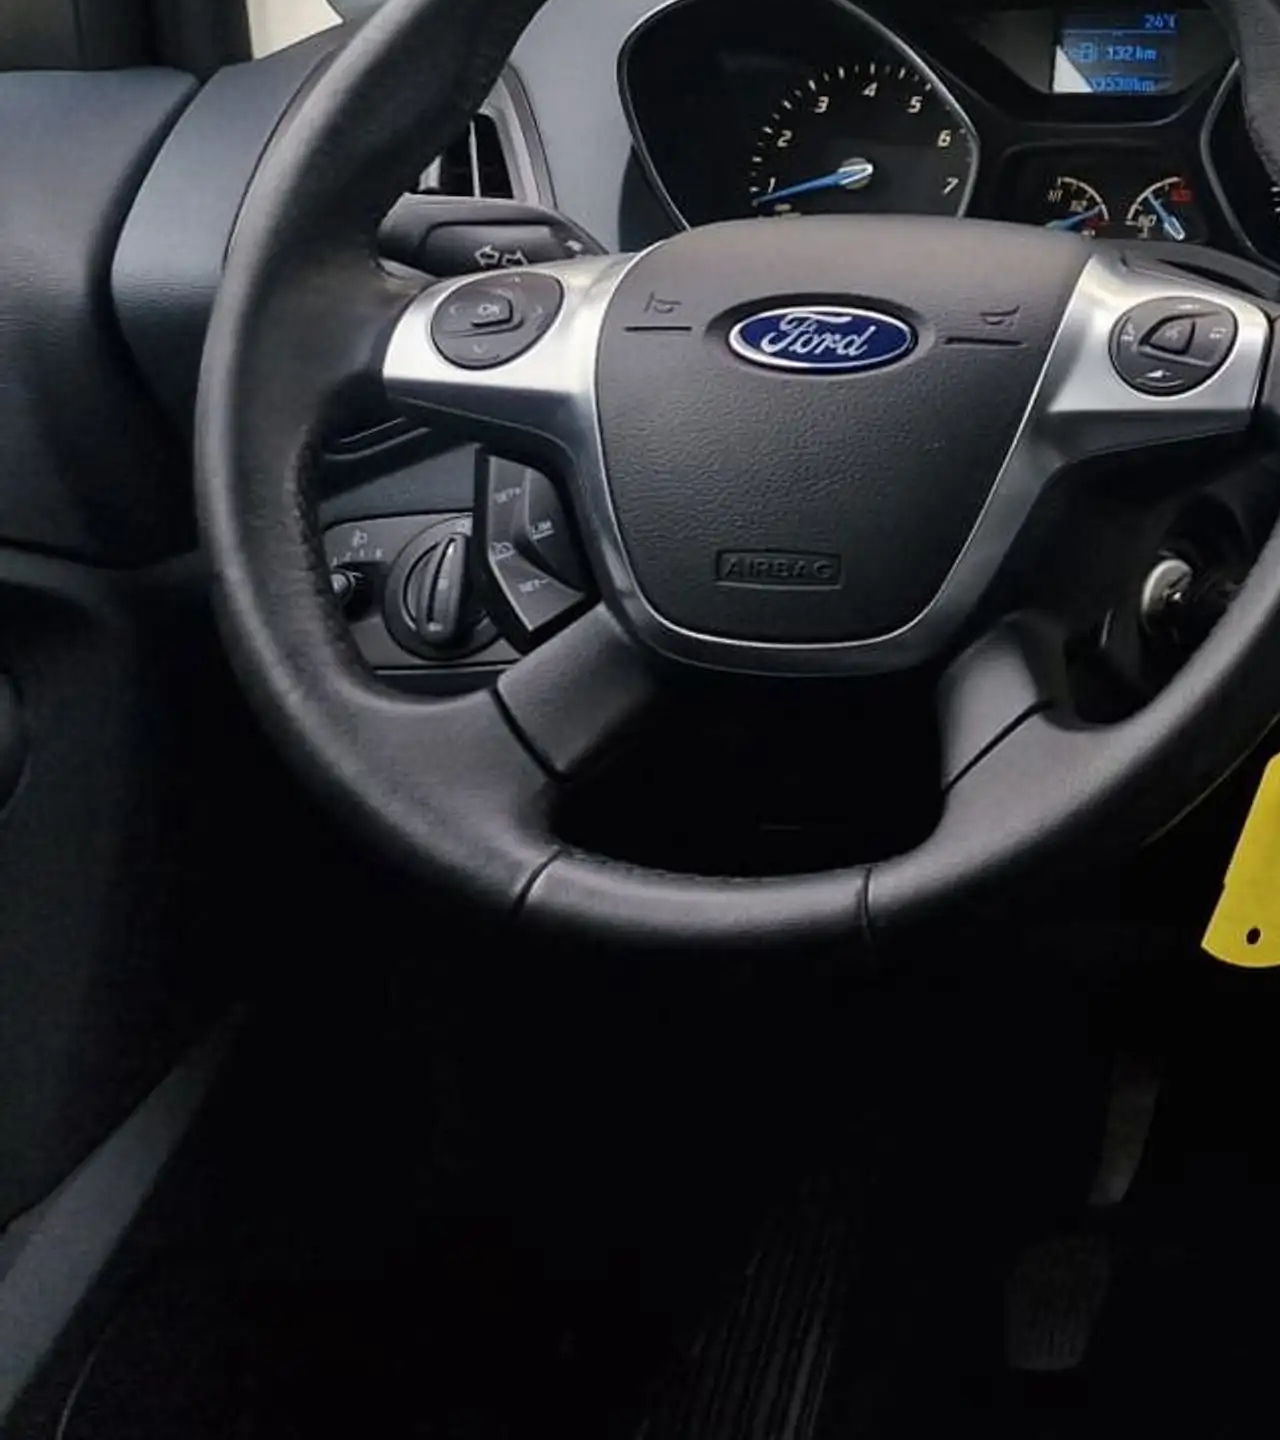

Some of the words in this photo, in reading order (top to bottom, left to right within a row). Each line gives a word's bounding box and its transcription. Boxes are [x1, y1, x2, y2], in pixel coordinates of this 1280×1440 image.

[861, 82, 878, 97] 4
[814, 96, 830, 113] 3
[907, 96, 923, 113] 5
[777, 130, 793, 147] 2
[936, 130, 952, 148] 6
[767, 176, 777, 194] 1
[943, 177, 960, 196] 7
[760, 312, 877, 356] Ford
[724, 558, 833, 579] AIRBAG
